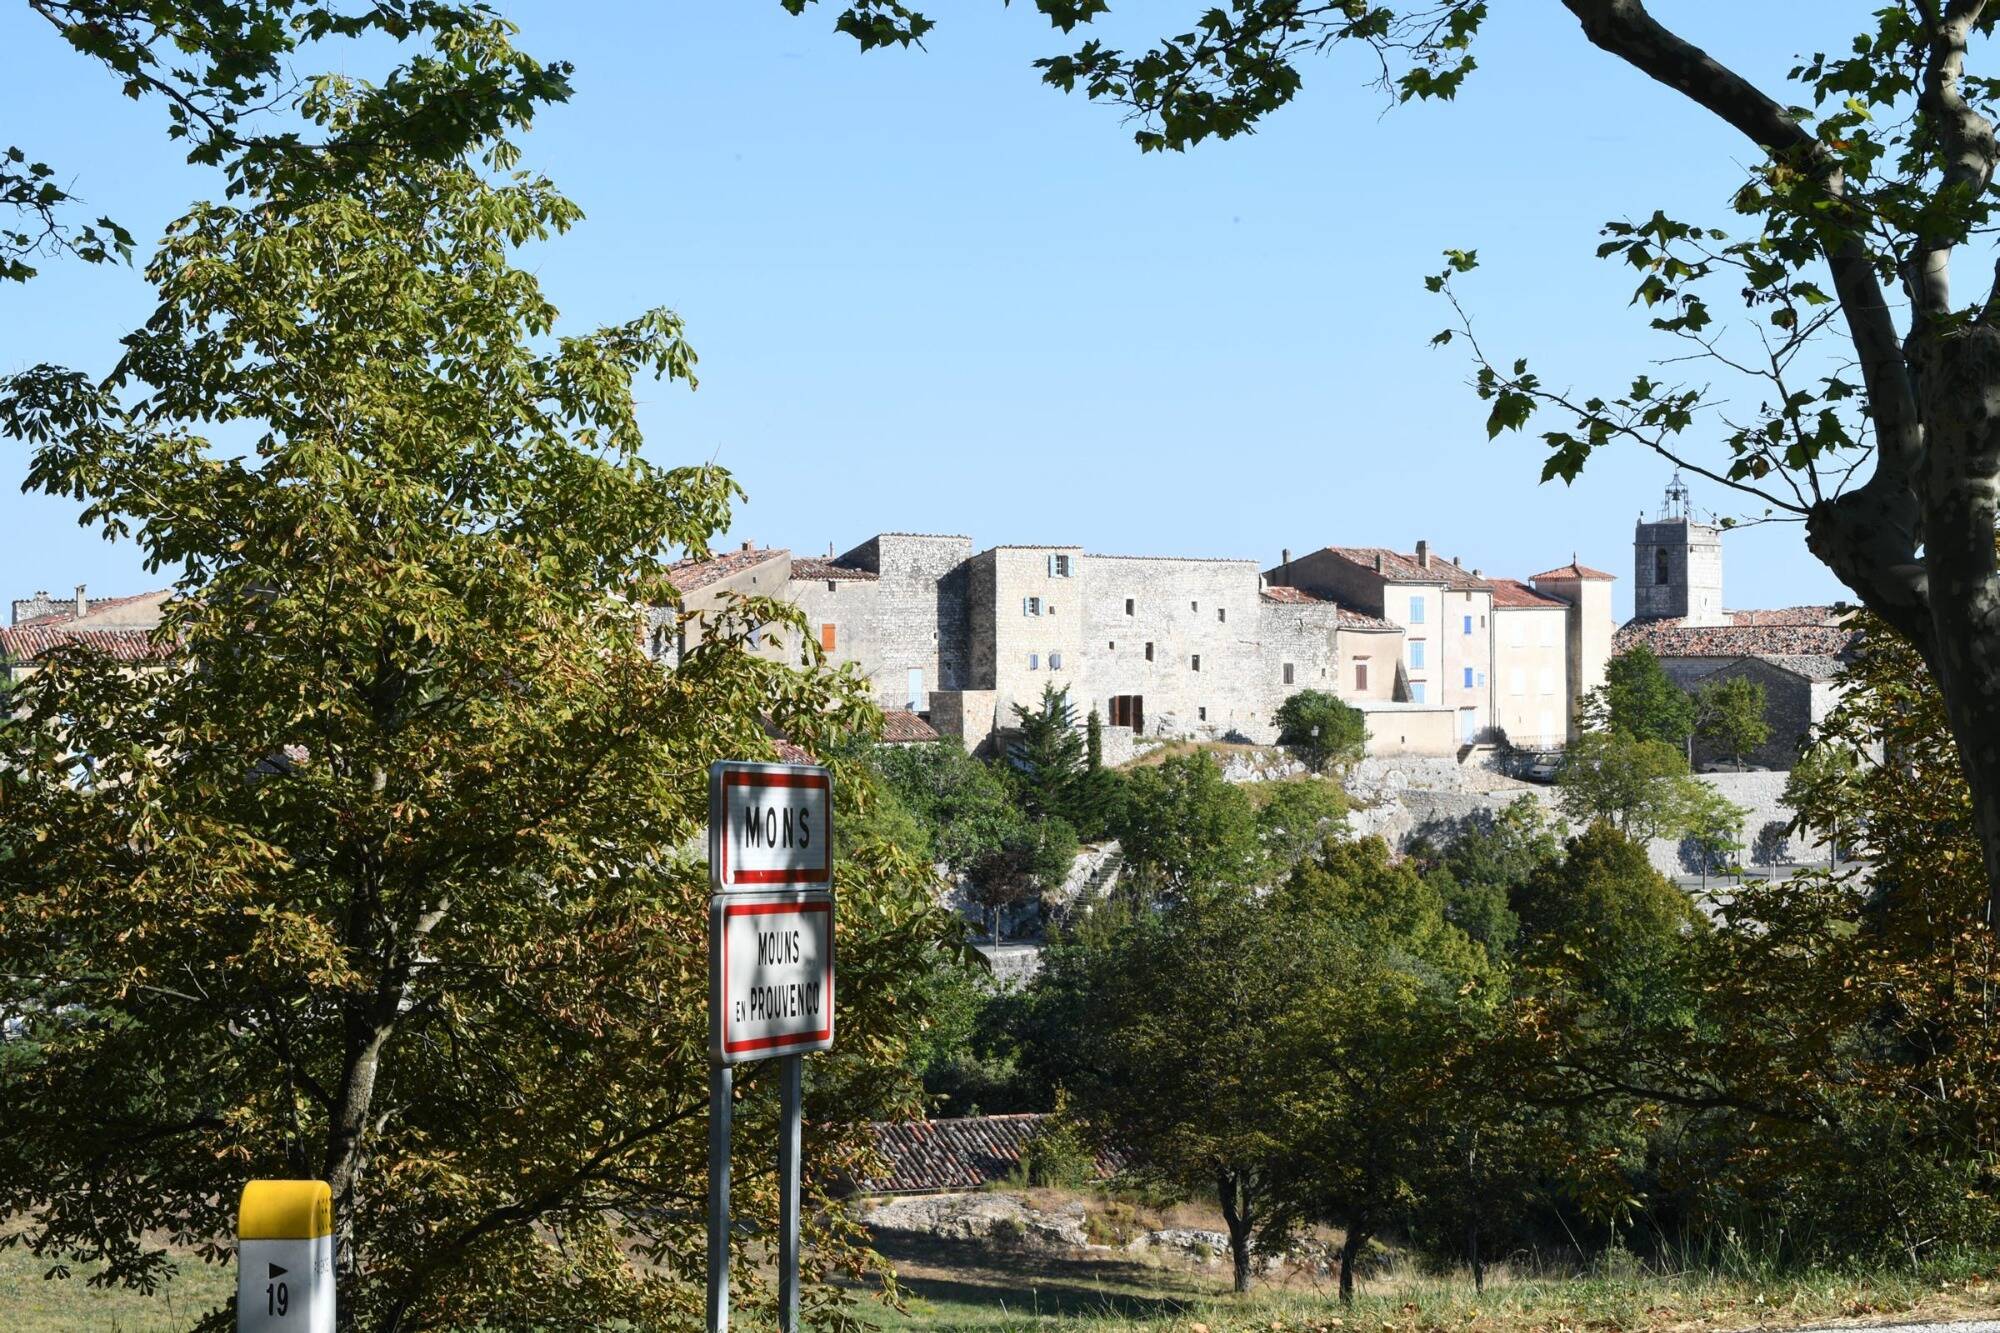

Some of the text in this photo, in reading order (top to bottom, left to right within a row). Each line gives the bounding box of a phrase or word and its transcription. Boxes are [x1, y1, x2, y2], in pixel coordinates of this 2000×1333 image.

[745, 806, 810, 849] MONS
[758, 930, 800, 966] MOUNS
[736, 981, 820, 1022] EN PROUVENCO
[266, 1282, 288, 1317] 19
